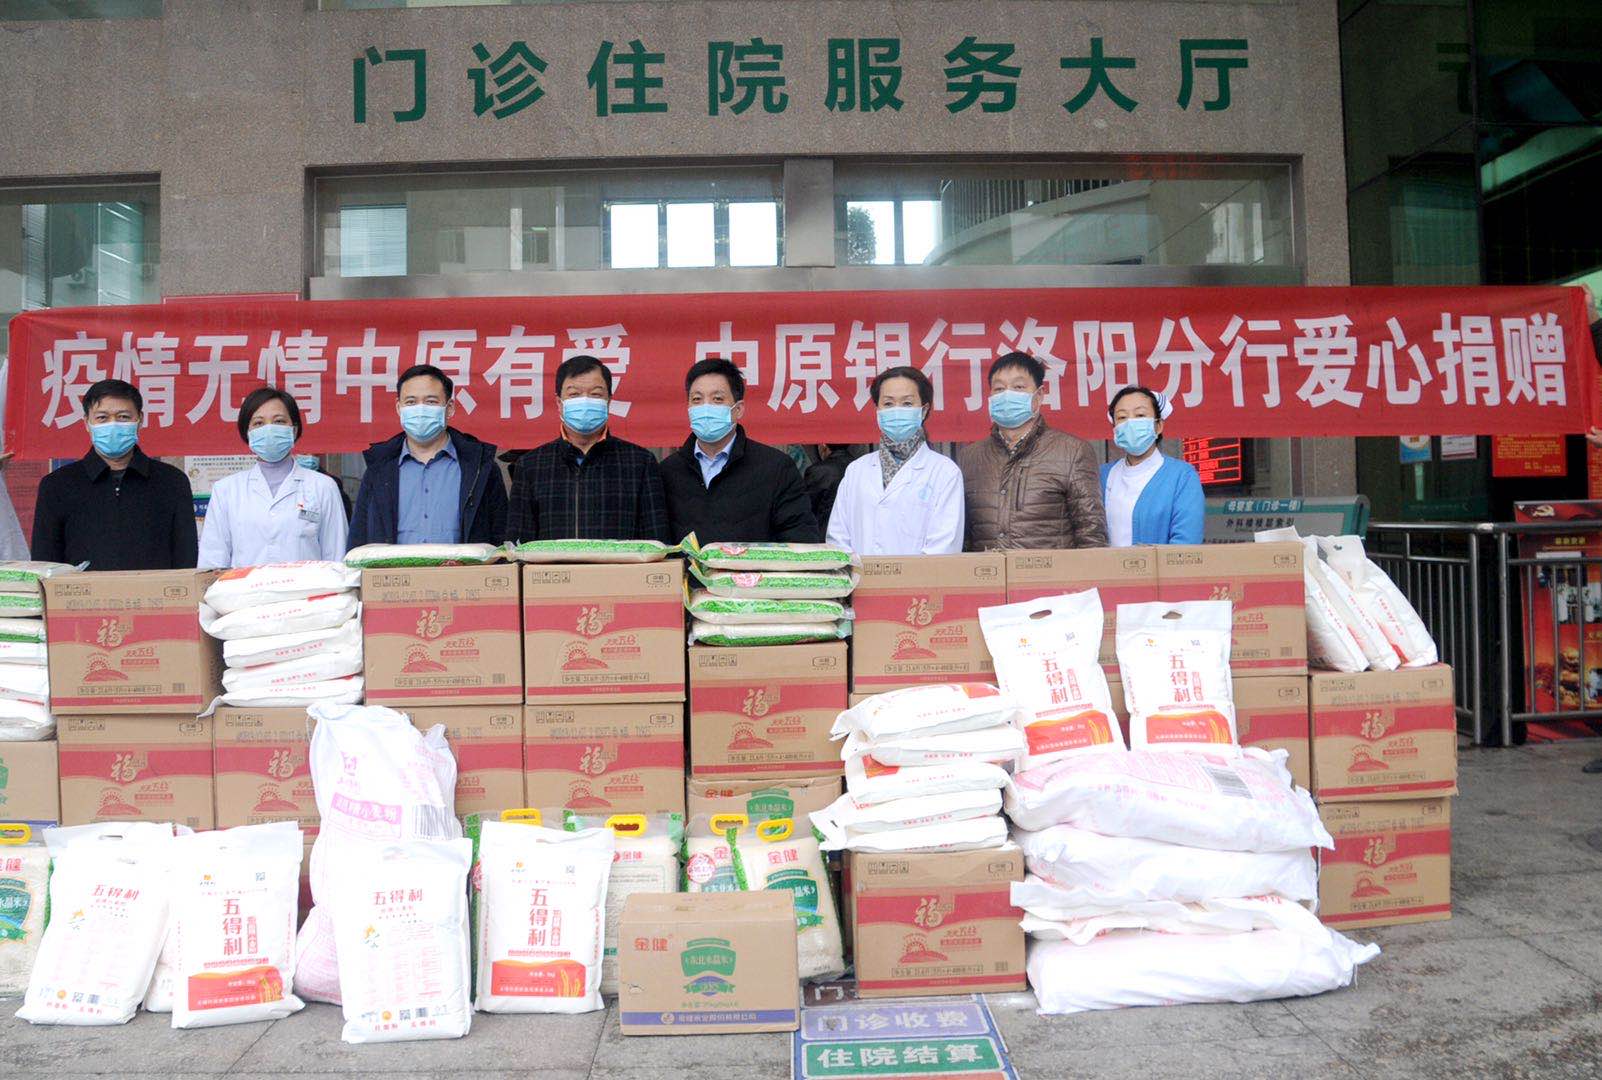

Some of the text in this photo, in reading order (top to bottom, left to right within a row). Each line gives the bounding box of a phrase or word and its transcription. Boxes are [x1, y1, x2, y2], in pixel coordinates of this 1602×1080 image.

[354, 36, 1249, 123] 门诊住院服务大厅
[41, 312, 1567, 434] 疫情无情中原有爱 中原银行洛阳分行爱心捐赠
[1042, 659, 1069, 705] 五得利
[1169, 655, 1191, 703] 五得利
[223, 898, 243, 956] 五得利
[528, 888, 548, 947] 五得利
[817, 1009, 969, 1032] 门诊收费
[816, 1044, 984, 1069] 住院结算
